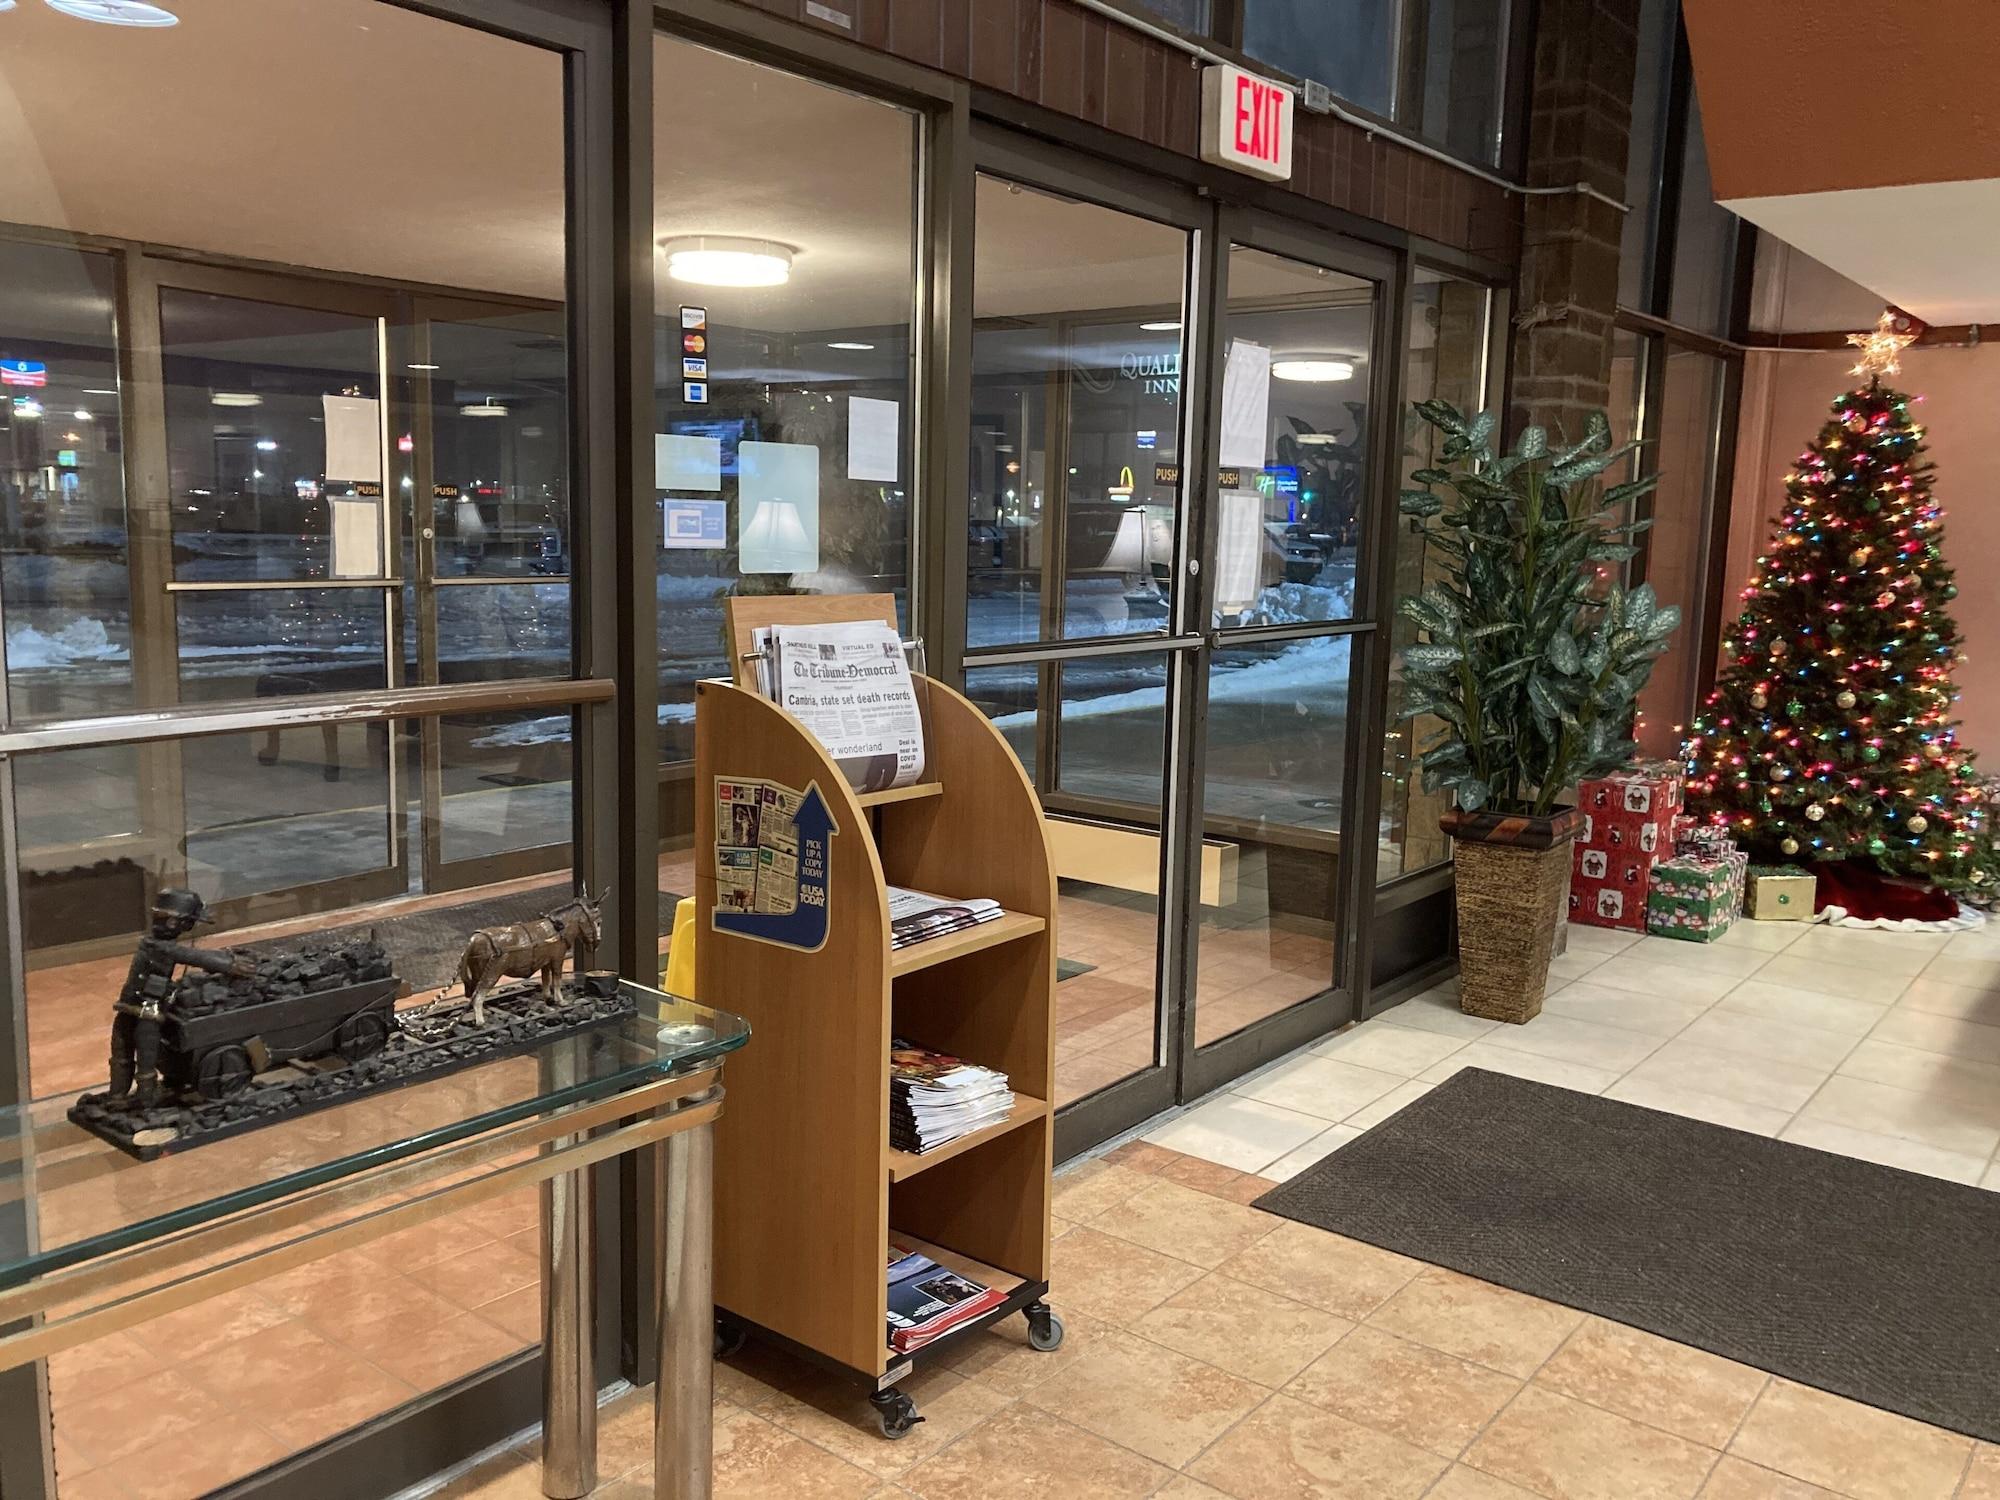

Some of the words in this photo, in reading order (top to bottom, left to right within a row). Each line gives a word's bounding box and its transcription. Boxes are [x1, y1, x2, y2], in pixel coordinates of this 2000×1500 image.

[1235, 75, 1284, 164] EXIT
[1120, 352, 1180, 379] QUALI
[1144, 379, 1179, 393] INN
[1155, 468, 1178, 481] PUSH
[1218, 472, 1238, 484] PUSH
[357, 485, 380, 495] PUSH
[434, 487, 457, 496] PUSH
[794, 661, 808, 677] The
[810, 660, 897, 678] Tribune-Democrat
[788, 694, 818, 707] Cambria,
[820, 695, 840, 706] state
[841, 693, 855, 705] set
[857, 692, 881, 704] death
[883, 691, 911, 702] records
[838, 742, 883, 754] wonderland
[806, 840, 822, 850] PICK
[806, 849, 816, 858] UP
[816, 850, 822, 860] A
[804, 859, 823, 869] COPY
[801, 867, 824, 878] TODAY
[807, 885, 825, 897] USA
[800, 893, 825, 907] TODAY
